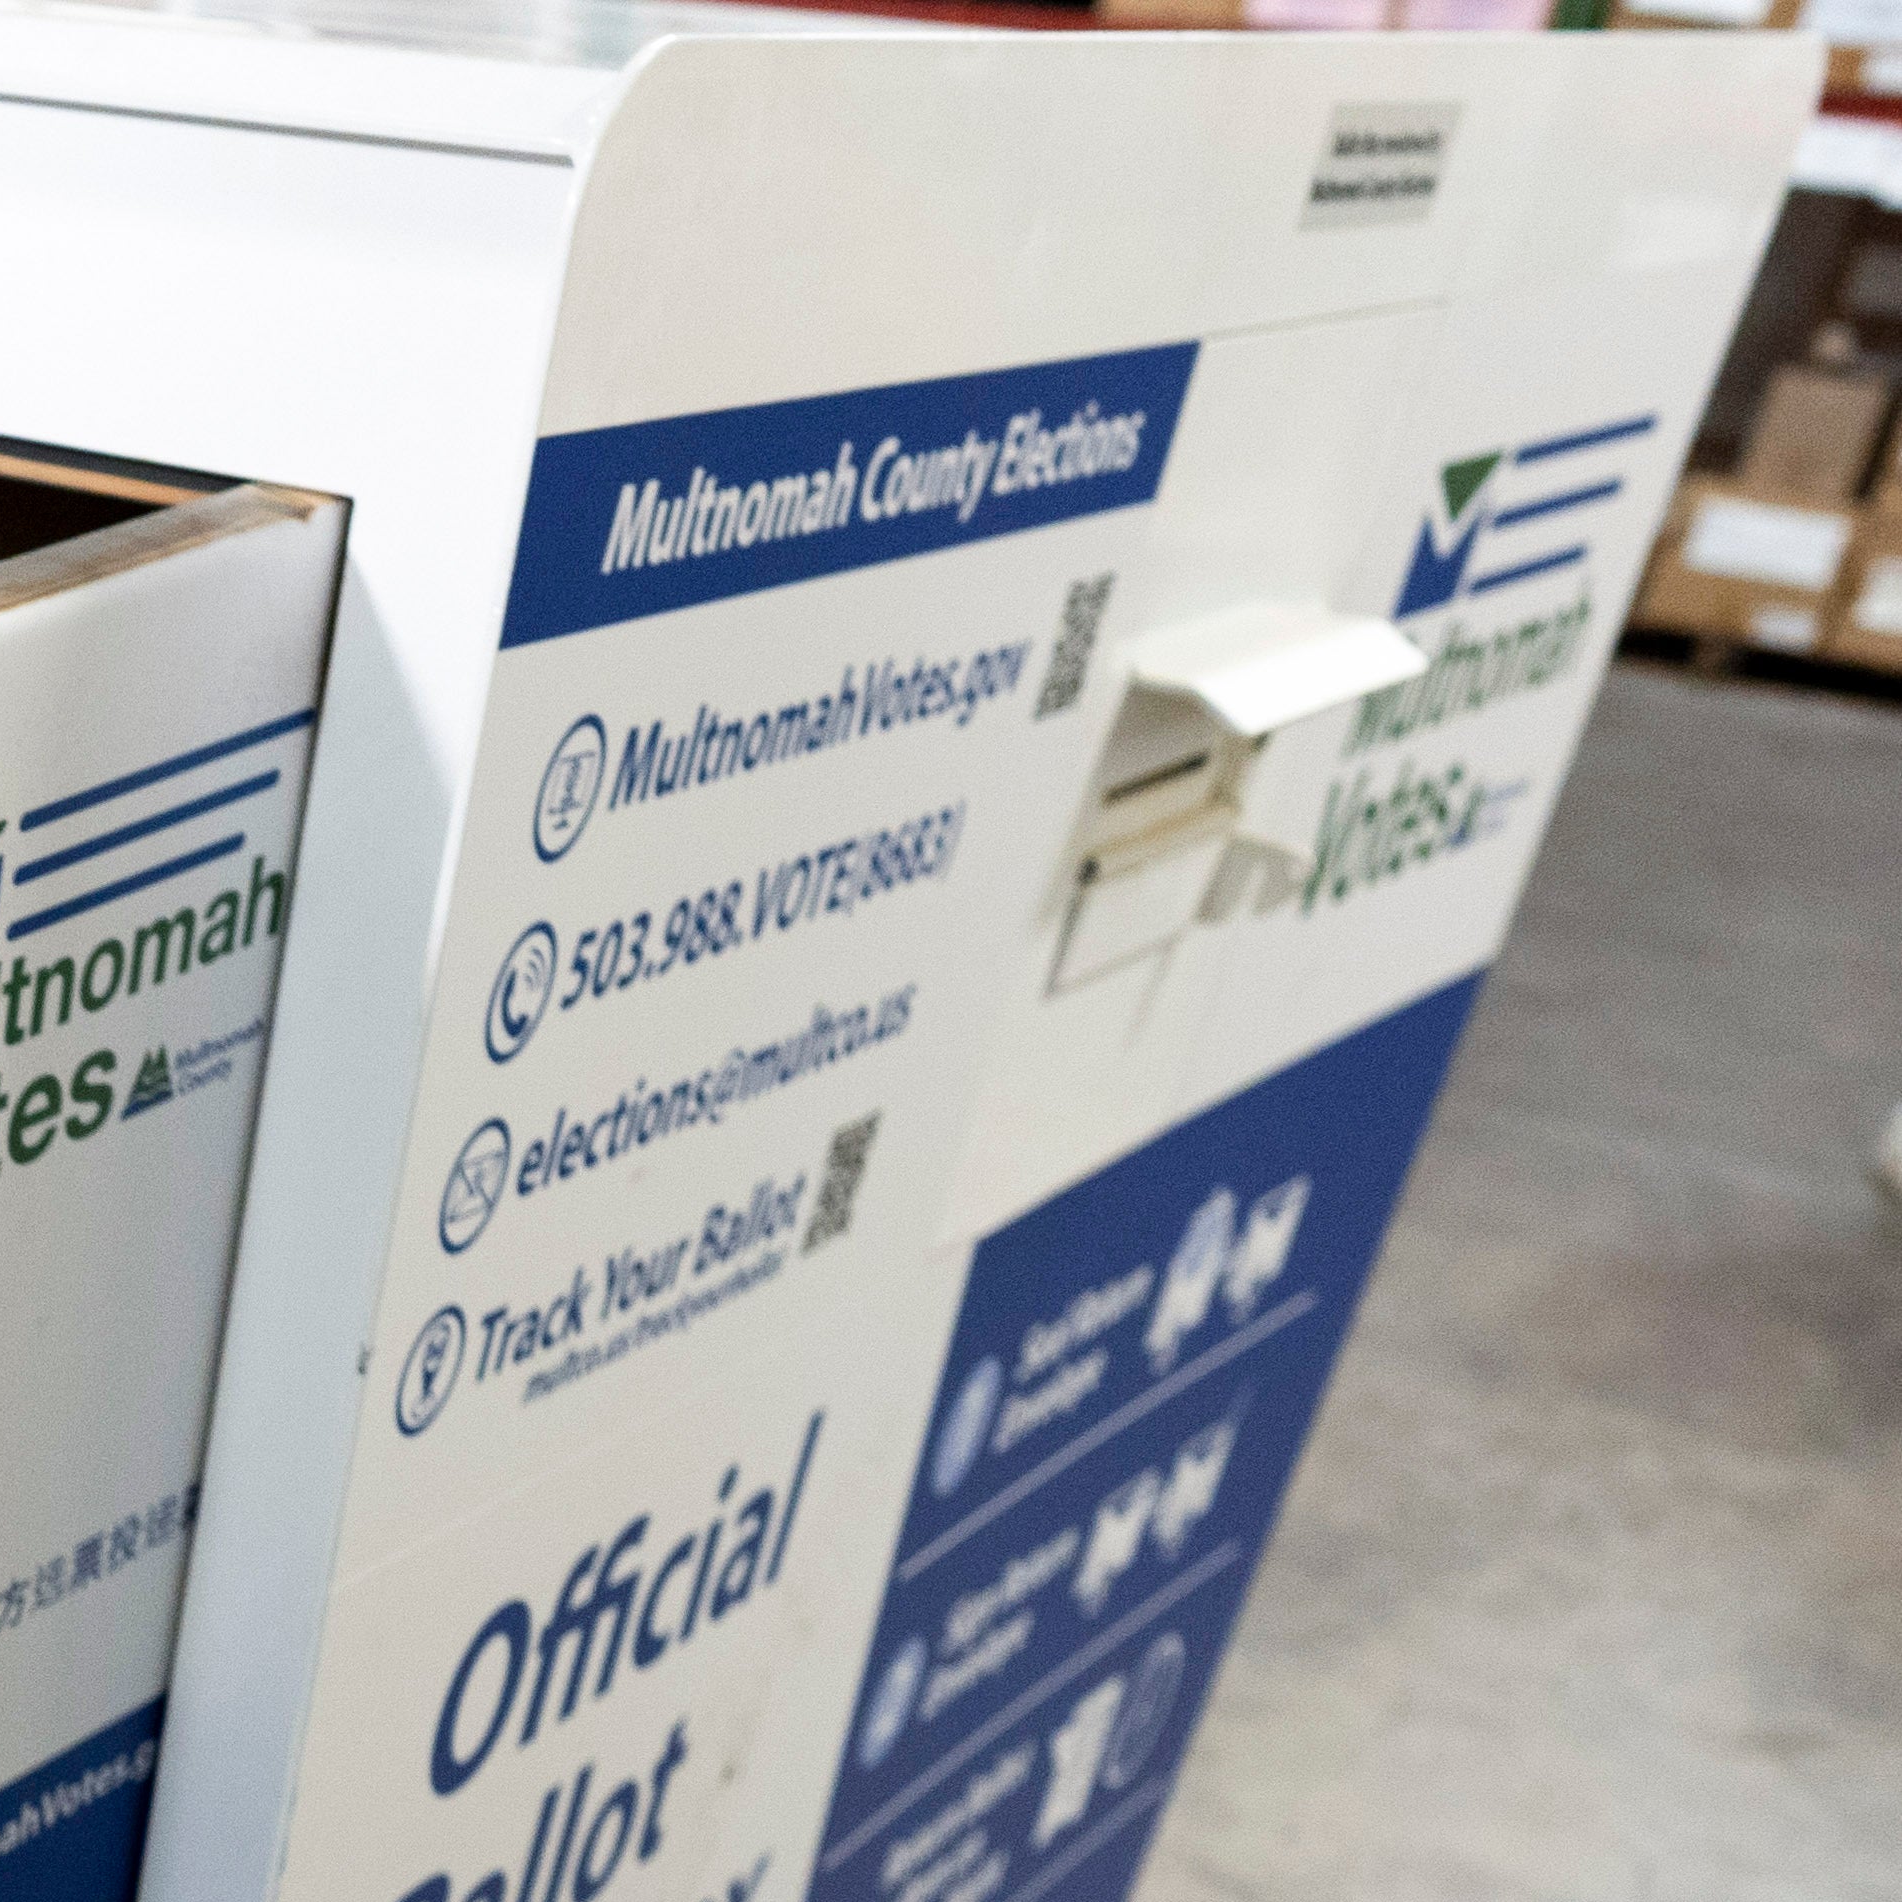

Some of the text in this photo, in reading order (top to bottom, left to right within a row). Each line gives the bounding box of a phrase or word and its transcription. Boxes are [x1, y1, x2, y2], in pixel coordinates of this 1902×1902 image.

[601, 402, 1148, 573] Multnomah County Elections
[607, 634, 1034, 812] MultnomahVotes.gov
[560, 798, 968, 1011] 503.988.VOTE(8683)
[516, 981, 918, 1198] elections@multco.us
[476, 1265, 592, 1381] Track
[601, 1238, 691, 1321] Your
[695, 1172, 806, 1276] Ballot
[429, 1409, 824, 1799] Official
